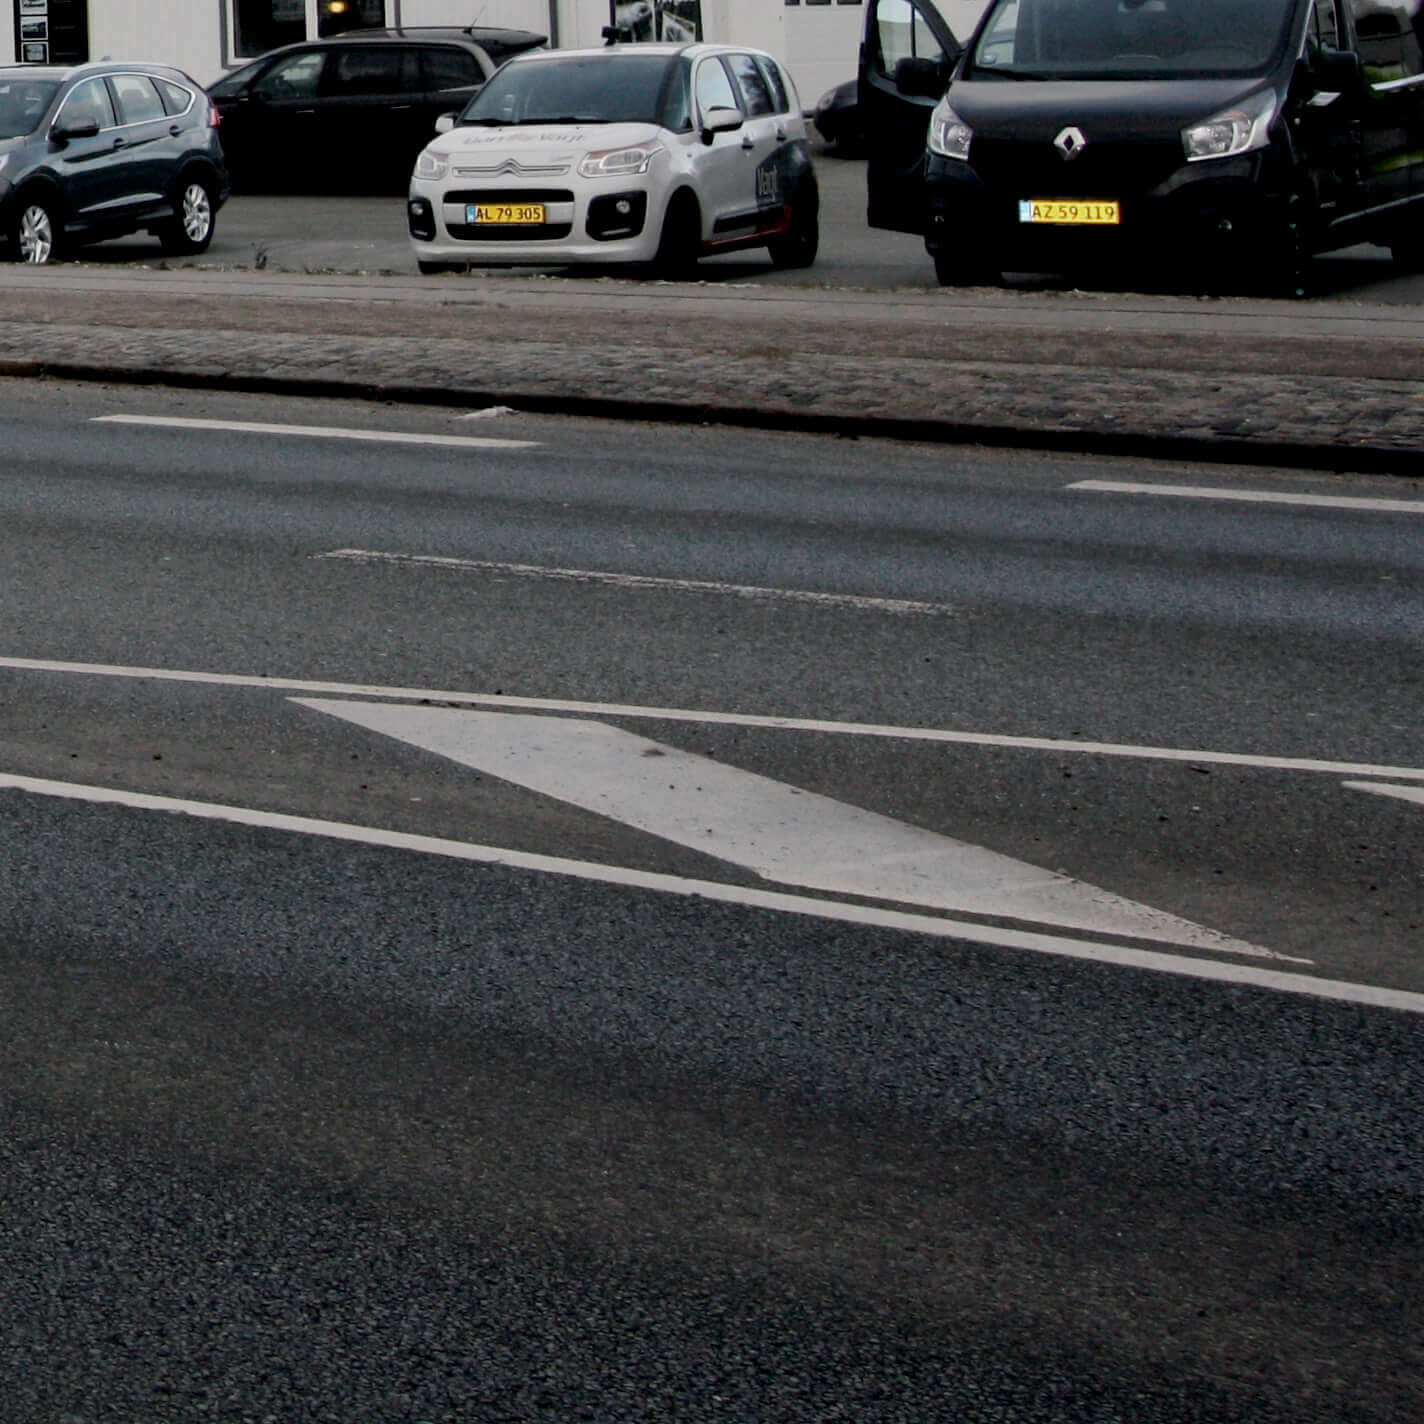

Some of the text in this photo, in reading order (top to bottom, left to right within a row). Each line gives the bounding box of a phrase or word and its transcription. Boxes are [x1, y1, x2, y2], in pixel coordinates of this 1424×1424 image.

[476, 207, 541, 220] AL 79 305
[1032, 205, 1114, 220] AZ 59 119
